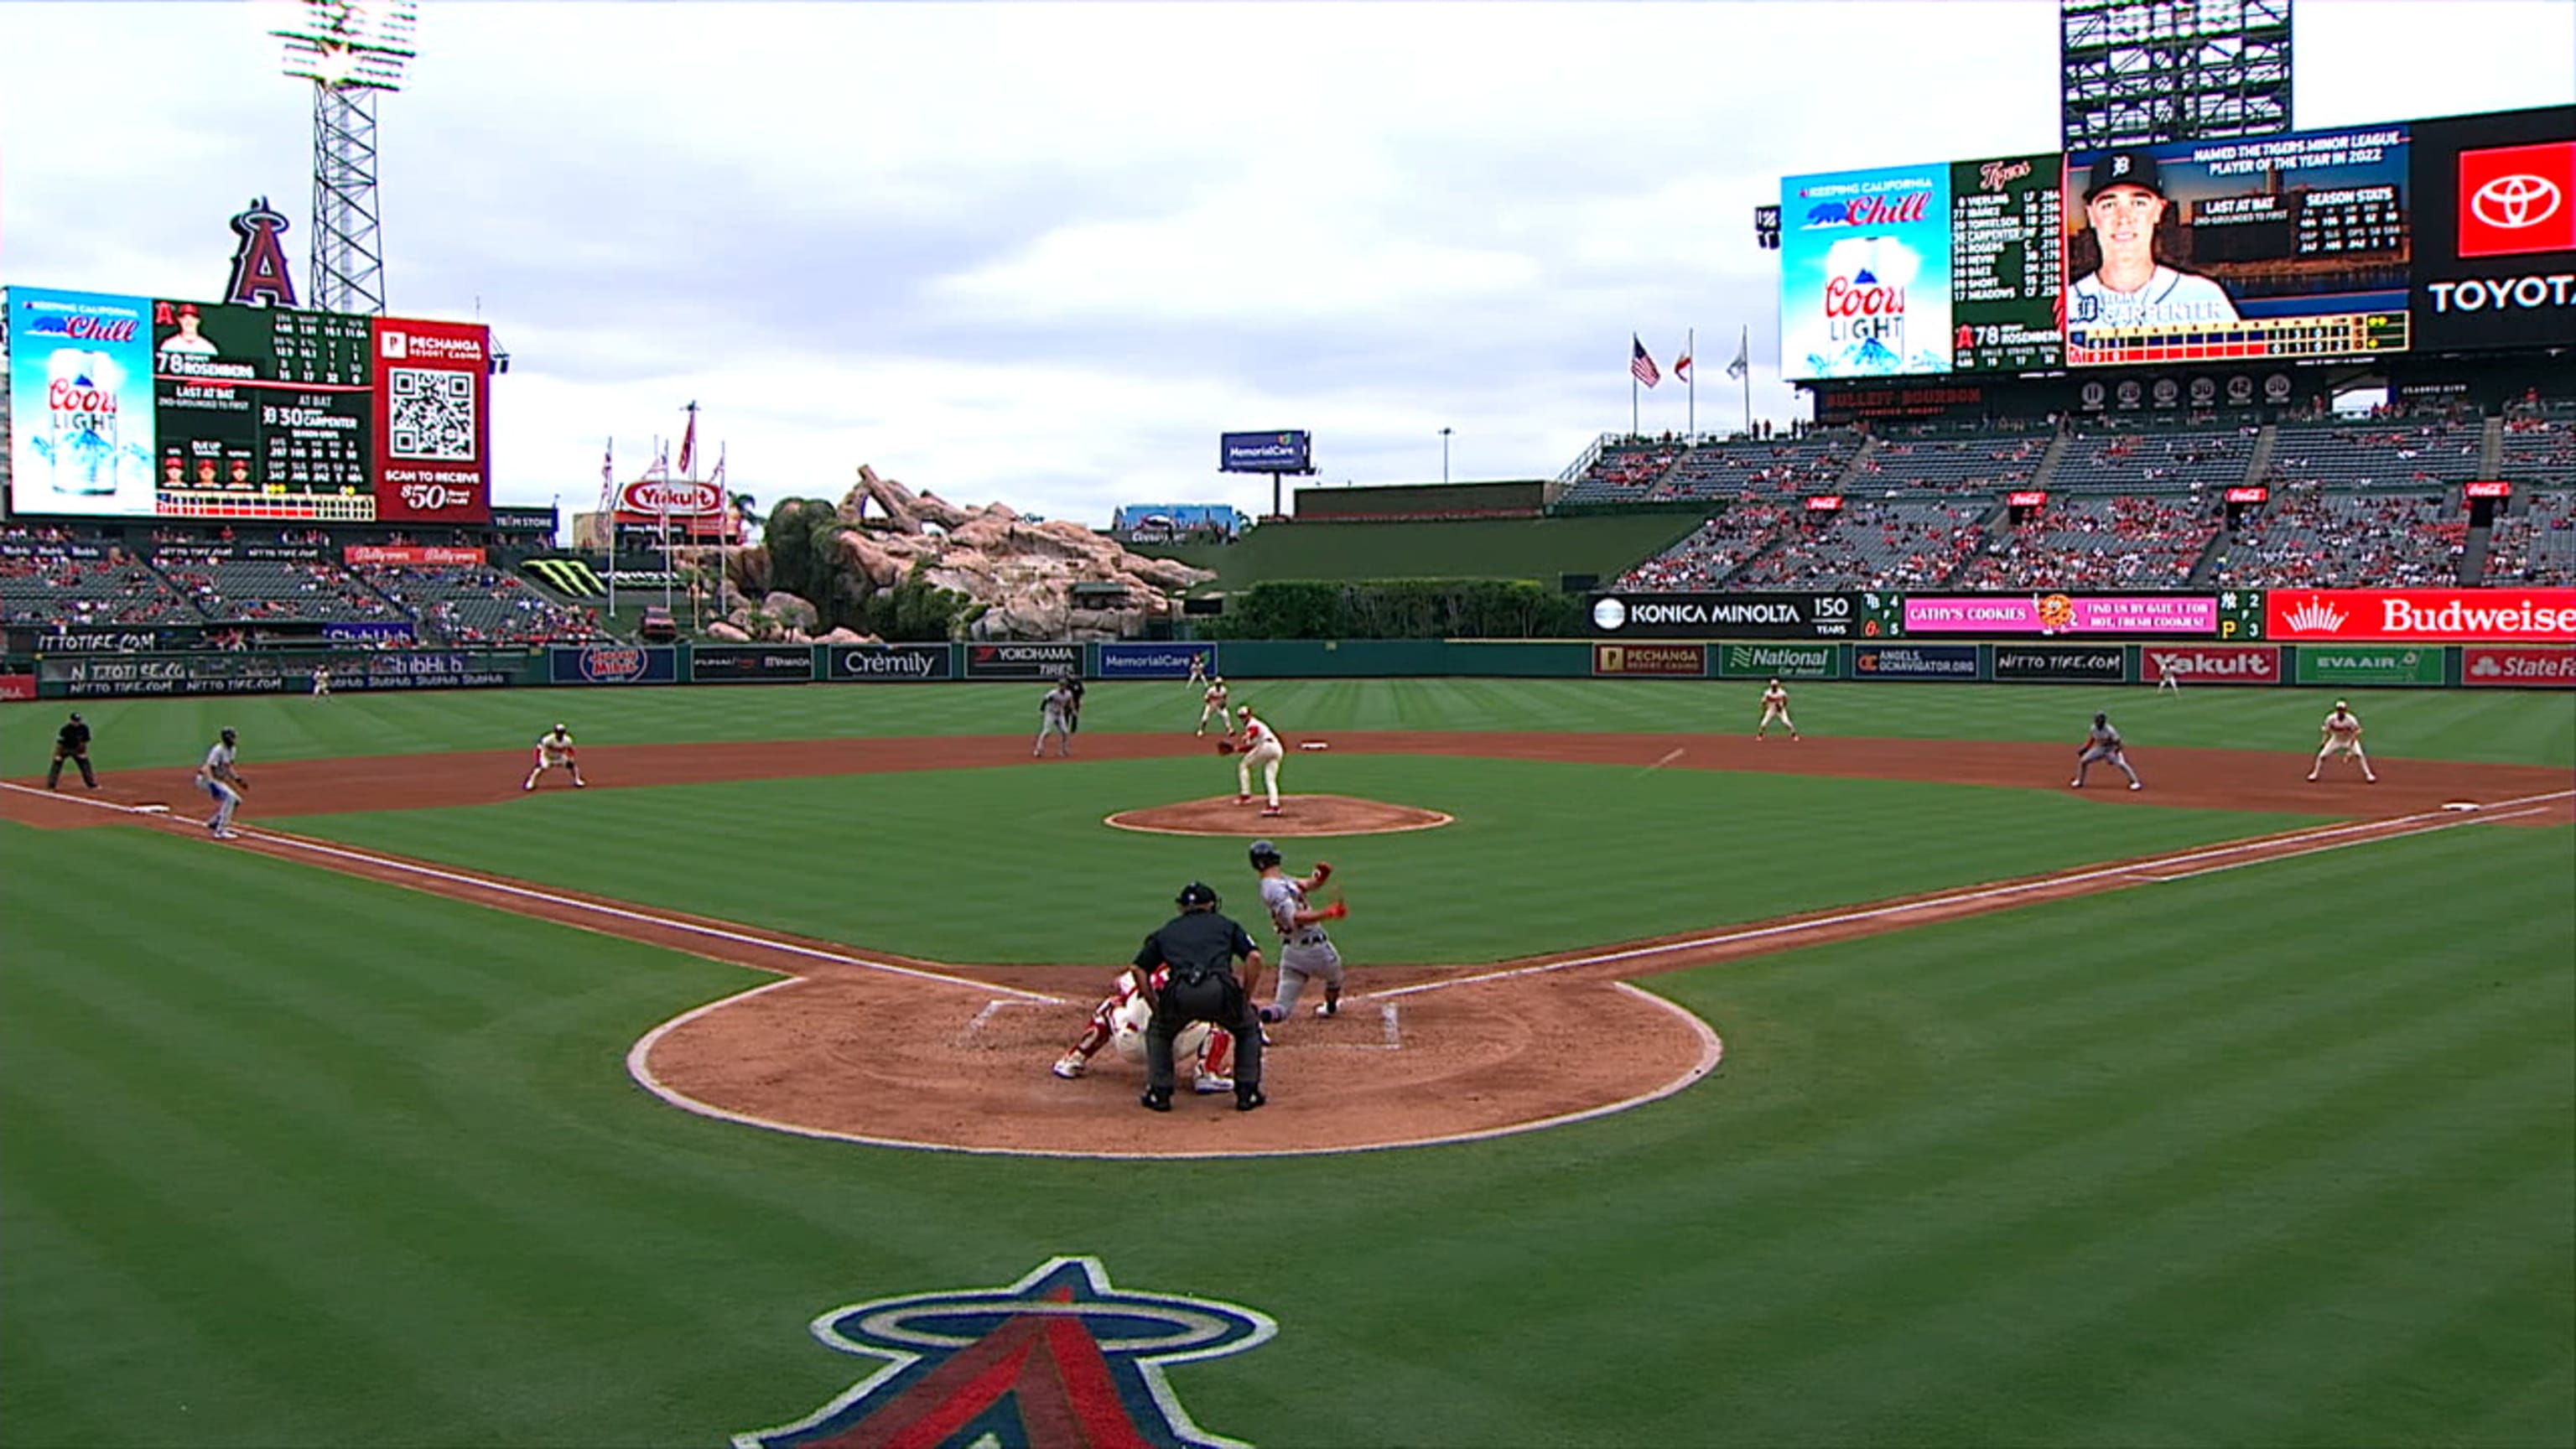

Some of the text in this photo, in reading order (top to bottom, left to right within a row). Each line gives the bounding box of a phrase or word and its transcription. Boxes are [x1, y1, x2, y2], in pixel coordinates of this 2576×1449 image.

[2194, 131, 2400, 162] NAMED THE TIGERS MINOR LEAGUE
[2210, 148, 2382, 175] PLAYER OF THE YEAR IN 2022
[2306, 187, 2393, 207] SEASON STATS
[1846, 191, 1932, 226] Chill
[2205, 197, 2275, 214] LAST AT BAT
[2428, 274, 2576, 313] TOYOT
[67, 315, 139, 341] Chill
[1831, 318, 1903, 340] LIGHT
[1975, 325, 1999, 346] 78
[409, 335, 480, 351] PECHANGA
[156, 352, 183, 374] 78
[2230, 381, 2249, 392] 42
[278, 408, 302, 427] 30
[1230, 447, 1294, 458] MemorialCare
[385, 470, 480, 484] SCAN TO RECEIVE
[1815, 598, 1849, 616] 150
[1889, 595, 1898, 607] 4
[2087, 603, 2111, 613] FIND
[2131, 603, 2144, 613] BY
[2187, 603, 2208, 613] FOR
[2250, 594, 2259, 606] 2
[1632, 605, 1800, 623] KONICA MINOLTA
[1968, 608, 2027, 621] COOKIES
[2381, 599, 2576, 631] Budweise
[1817, 626, 1846, 635] YEARS
[1890, 624, 1898, 636] 5
[2222, 621, 2259, 638] P 3
[998, 647, 1073, 661] YOKOHAMA
[1106, 656, 1190, 668] MemorialCare
[1628, 650, 1697, 661] PECHANGA
[1753, 649, 1828, 665] National
[1999, 654, 2121, 669] NITTO TIRE.COM
[1039, 666, 1074, 677] TIRES
[1879, 661, 1974, 672] OCNAVIGATOR.ORG
[2151, 653, 2271, 674] Yakult
